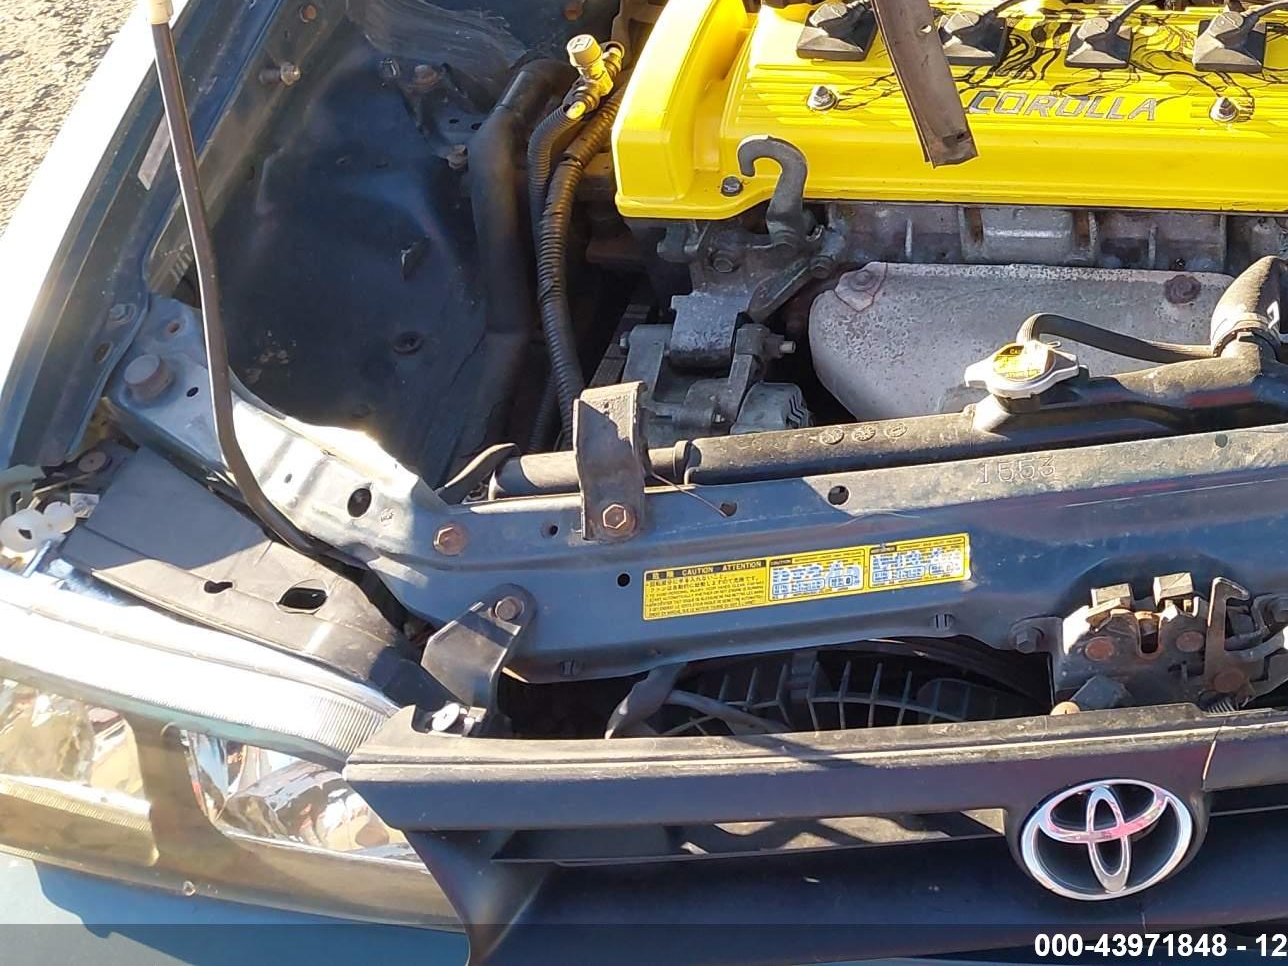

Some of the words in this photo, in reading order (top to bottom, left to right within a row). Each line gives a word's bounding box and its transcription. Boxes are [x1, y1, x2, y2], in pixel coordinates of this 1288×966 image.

[967, 90, 1157, 121] COROLLA
[976, 454, 1056, 485] 1553
[682, 566, 713, 576] CAUTION
[722, 561, 762, 571] ATTENTION
